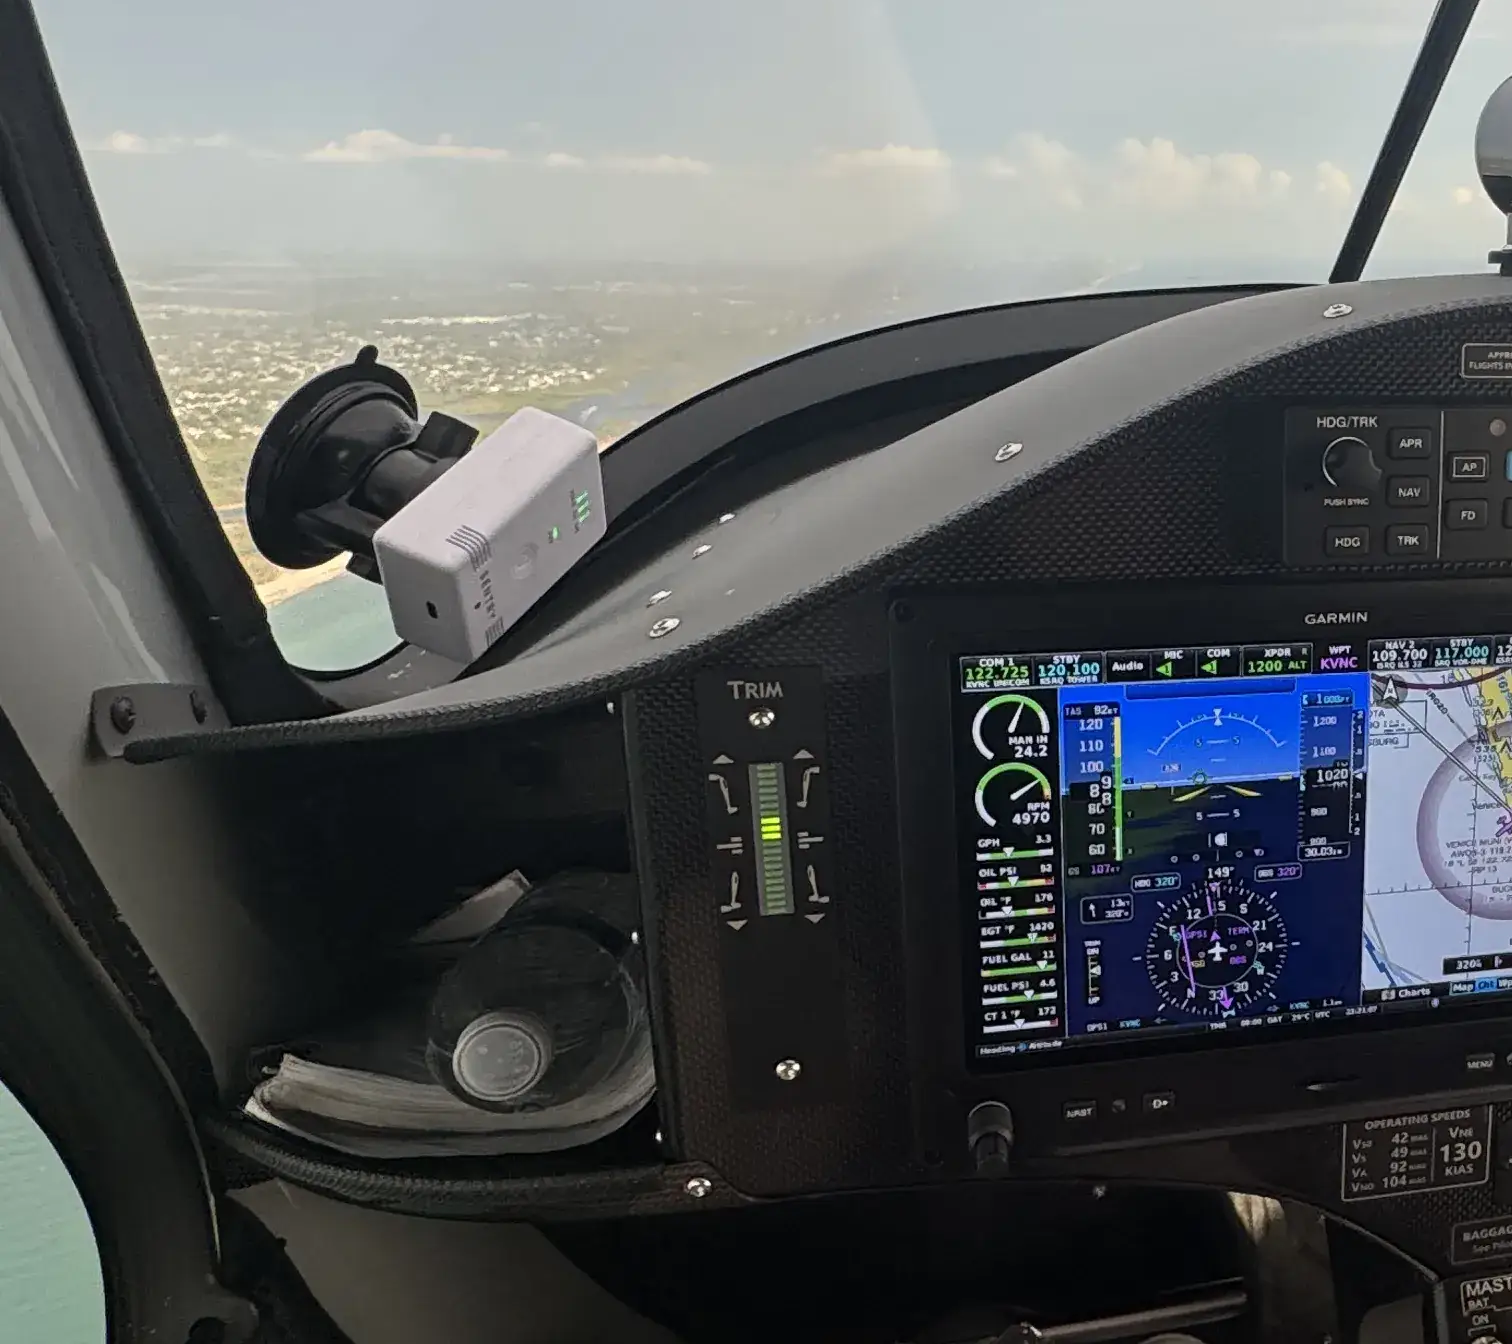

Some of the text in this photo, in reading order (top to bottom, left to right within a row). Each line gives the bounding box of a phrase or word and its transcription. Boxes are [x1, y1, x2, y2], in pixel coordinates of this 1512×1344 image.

[1469, 362, 1504, 370] FLIGHTS
[1316, 416, 1378, 429] HDG/TRK
[1399, 438, 1422, 449] APR
[1461, 462, 1478, 472] AP
[1398, 488, 1421, 498] NAV
[1324, 497, 1370, 506] PUSH SYNC
[1461, 510, 1476, 520] FD
[1335, 537, 1361, 547] HDG
[1398, 535, 1420, 546] TRK
[1304, 612, 1369, 625] GARMIN
[1450, 638, 1474, 648] STBY
[1207, 648, 1231, 658] COM
[1264, 648, 1291, 658] XPDR
[1329, 645, 1351, 655] WPT
[1372, 648, 1429, 662] 109.700
[1435, 646, 1490, 660] 117.000
[979, 657, 1004, 667] COM
[1052, 654, 1081, 665] STBY
[1320, 656, 1358, 670] KVNC
[1038, 663, 1101, 677] 120.100
[1112, 661, 1144, 672] Audio
[1248, 660, 1308, 674] 1200 ALT
[965, 665, 1029, 681] 122.725
[727, 680, 783, 700] TRIM
[1079, 719, 1103, 731] 120
[1313, 715, 1337, 727] 1200
[1008, 735, 1033, 745] MAN
[1079, 739, 1104, 752] 110
[1014, 744, 1048, 758] 24.2
[1080, 761, 1104, 773] 100
[1027, 802, 1050, 812] RPM
[1012, 812, 1050, 826] 4970
[1088, 823, 1106, 835] 70
[977, 837, 1000, 848] GPH
[978, 866, 1018, 878] OIL PSI
[982, 952, 1032, 965] FUEL GAL
[983, 981, 1030, 993] FUEL PSI
[1398, 986, 1431, 998] Charts
[1452, 982, 1475, 994] Map
[980, 1044, 1016, 1055] Heading
[1467, 1059, 1493, 1069] MENU
[1066, 1108, 1093, 1118] NRST
[1364, 1108, 1471, 1131] OPERATING SPEEDS
[1391, 1131, 1409, 1144] 42
[1390, 1146, 1409, 1158] 49
[1439, 1140, 1483, 1163] 130
[1389, 1160, 1408, 1174] 92
[1445, 1163, 1474, 1177] KIAS
[1382, 1174, 1408, 1189] 104
[1468, 1297, 1491, 1309] BAT
[1472, 1313, 1490, 1325] ON
